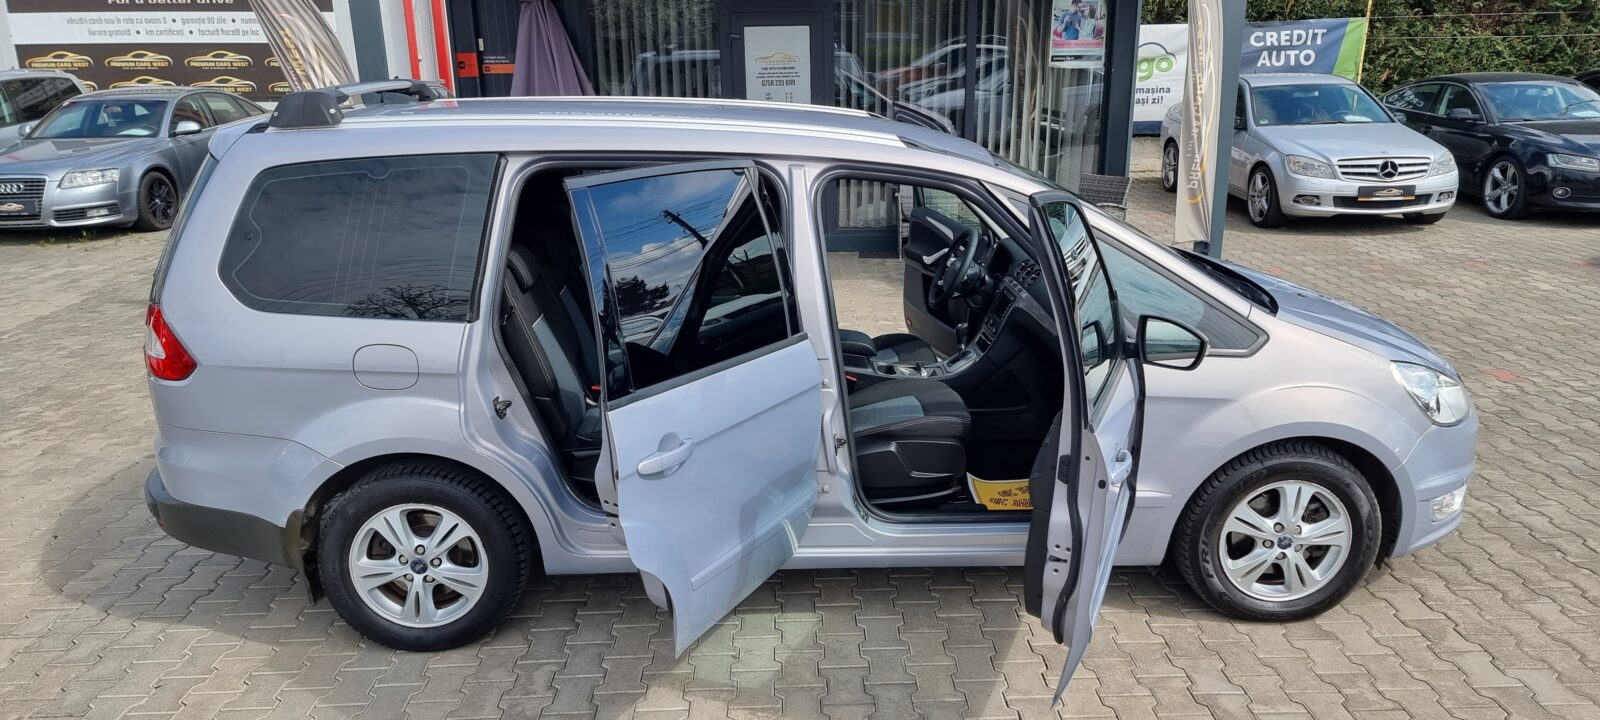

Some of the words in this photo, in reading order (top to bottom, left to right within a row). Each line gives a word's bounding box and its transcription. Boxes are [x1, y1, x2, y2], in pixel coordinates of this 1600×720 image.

[216, 17, 227, 25] zile
[145, 28, 155, 36] km
[1249, 28, 1328, 47] CREDIT
[1256, 49, 1316, 67] AUTO
[1151, 95, 1164, 105] zi!
